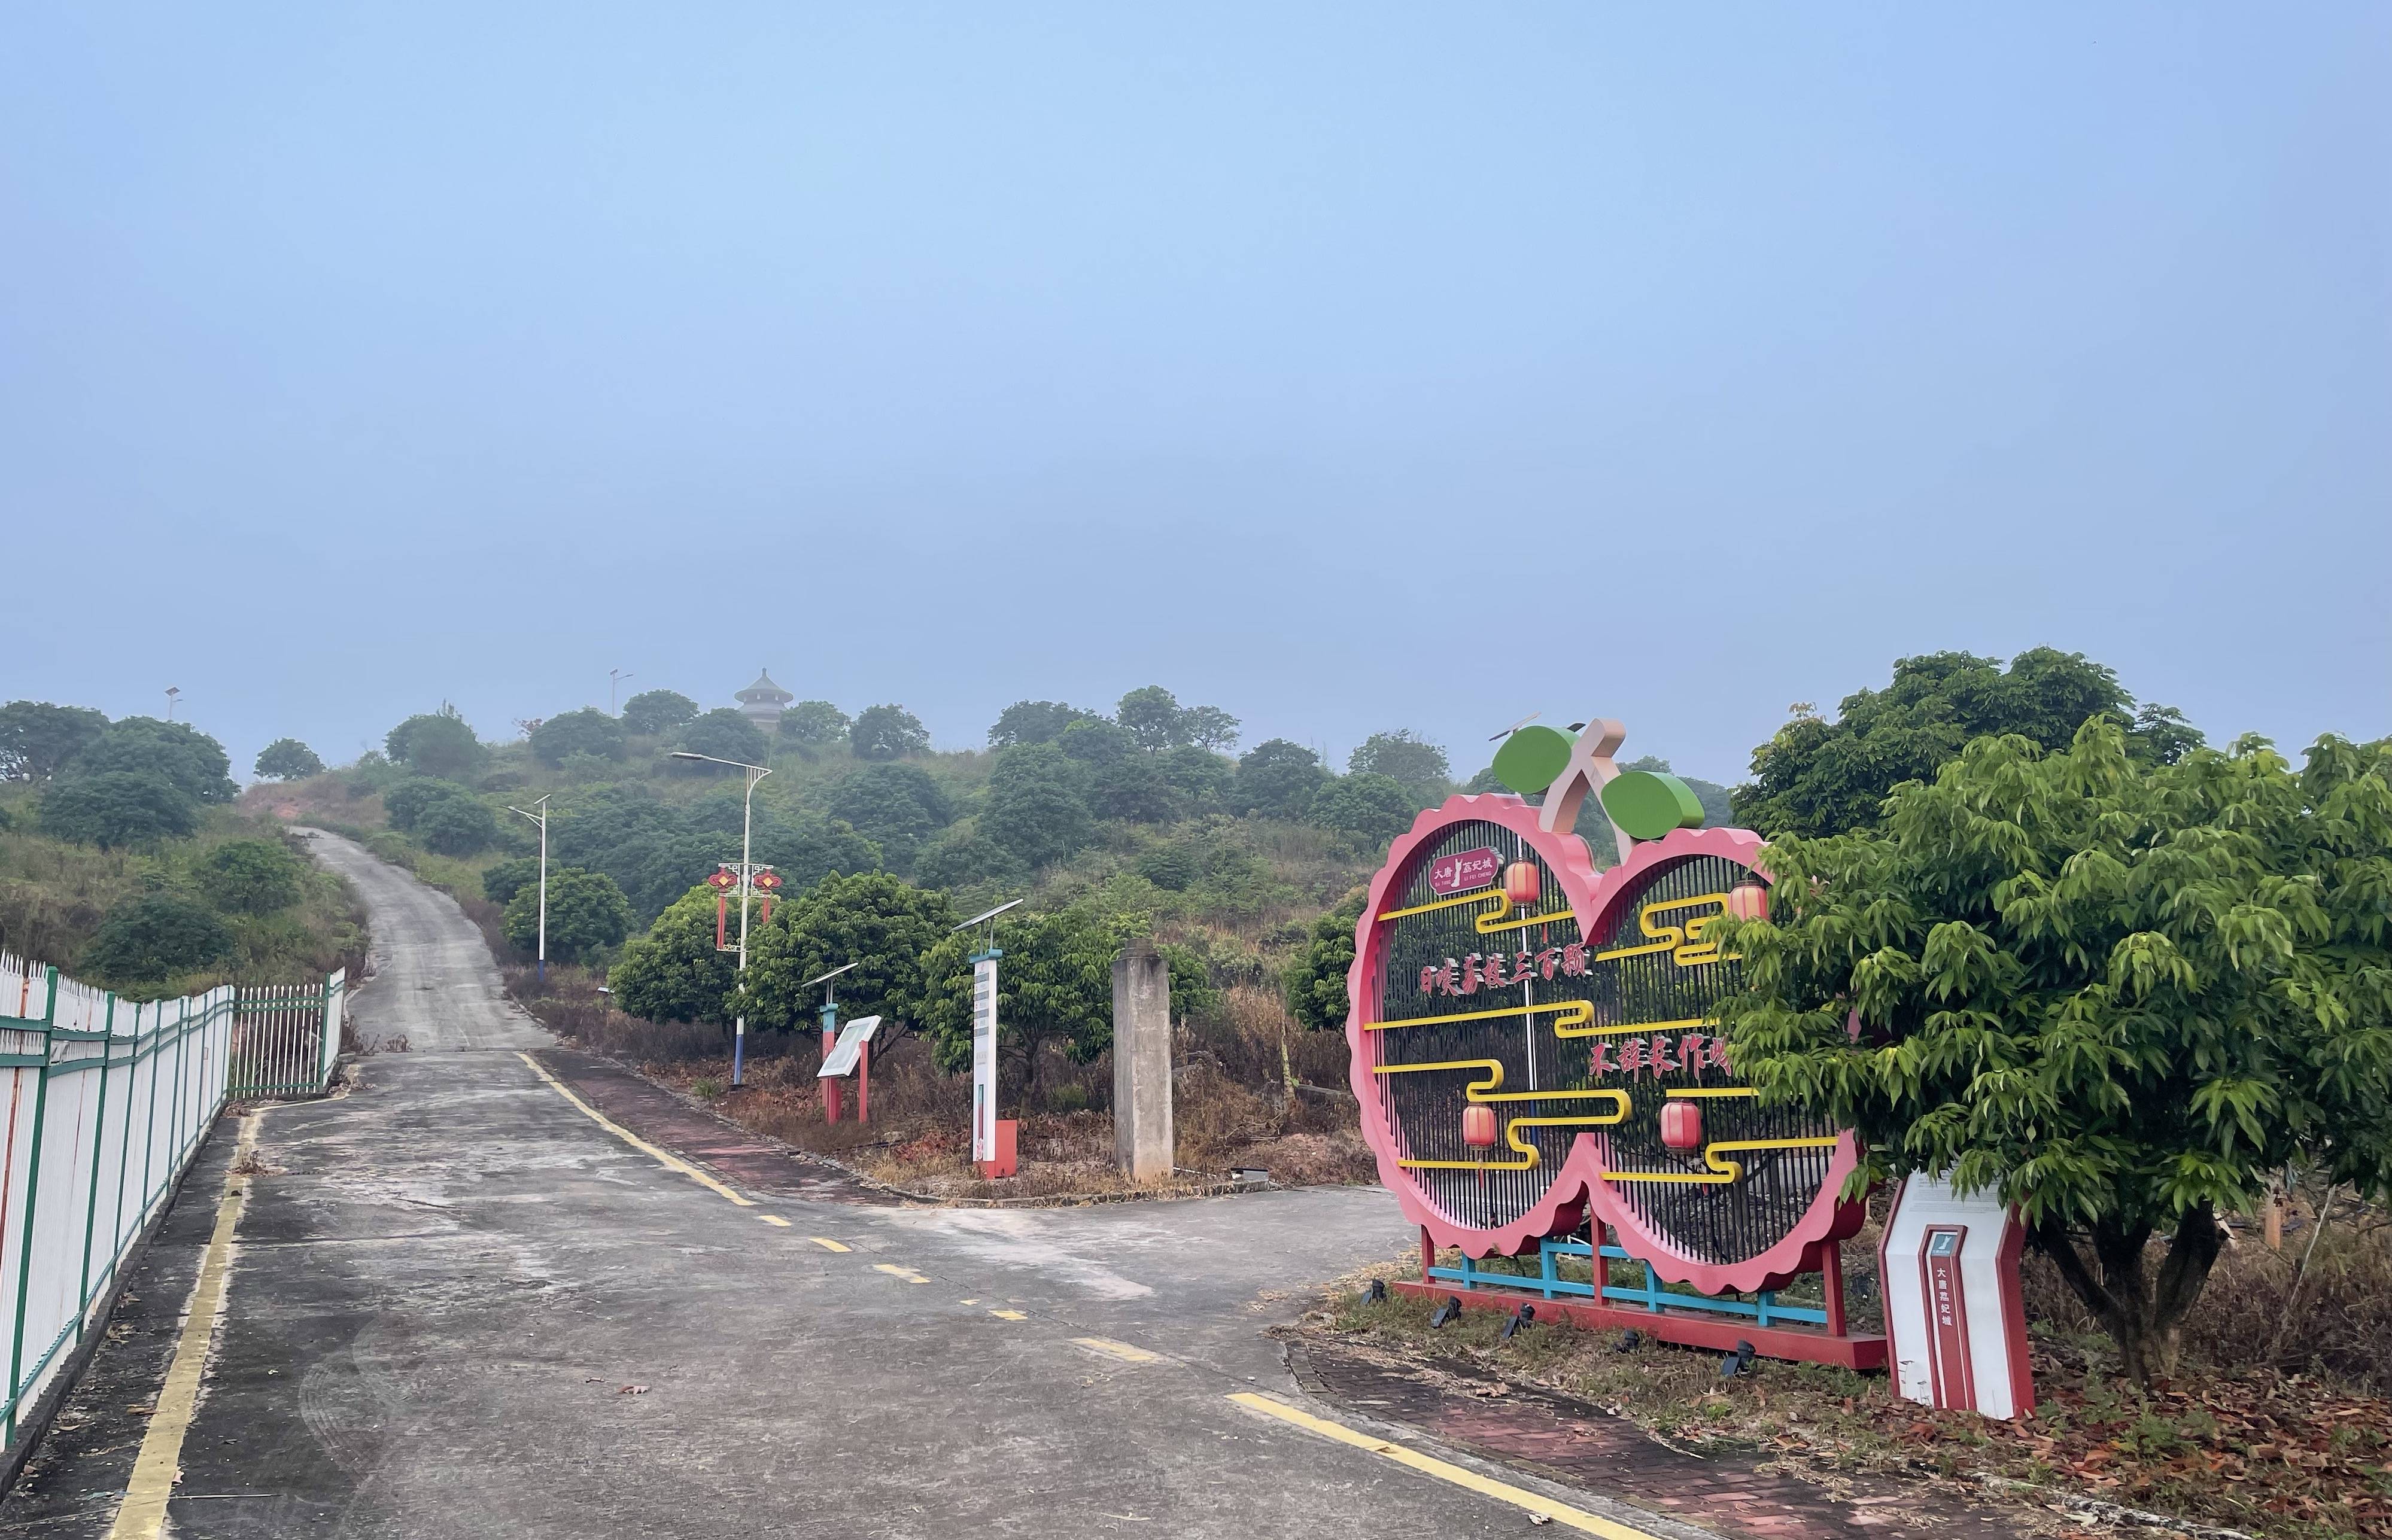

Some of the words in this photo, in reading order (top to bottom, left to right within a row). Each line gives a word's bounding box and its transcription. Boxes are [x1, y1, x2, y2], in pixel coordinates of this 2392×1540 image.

[1434, 866, 1453, 879] 大唐
[1420, 941, 1586, 996] 日啖荔枝三百颗
